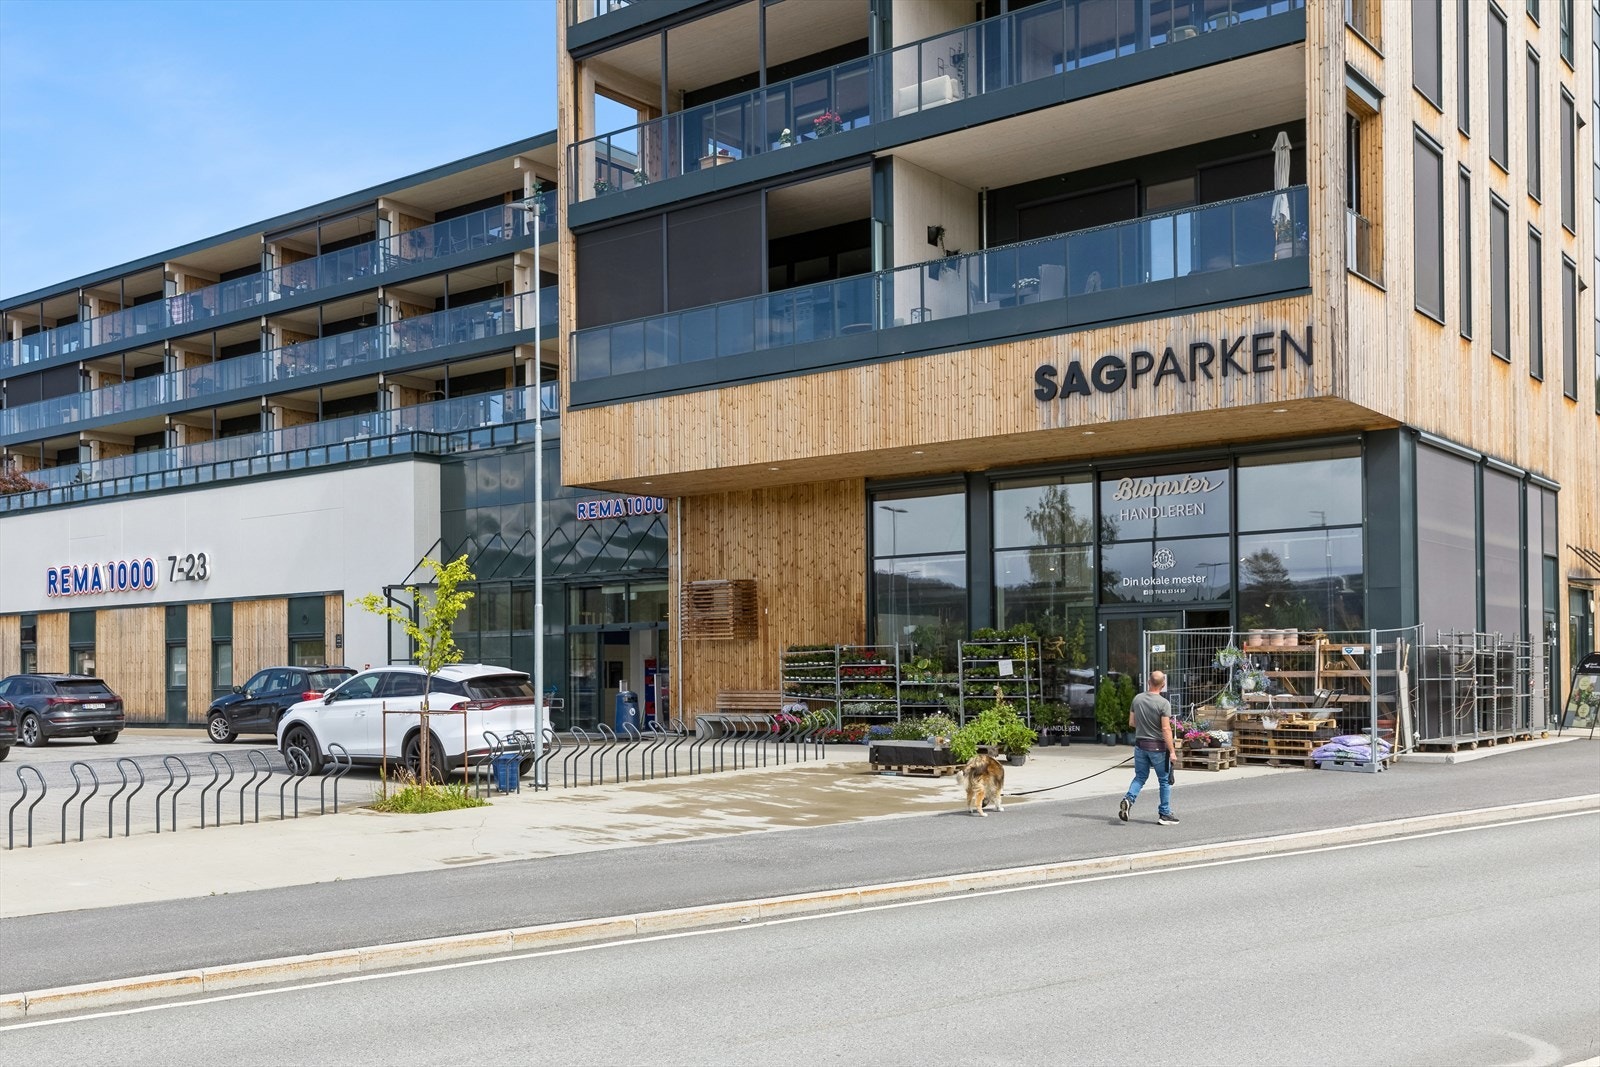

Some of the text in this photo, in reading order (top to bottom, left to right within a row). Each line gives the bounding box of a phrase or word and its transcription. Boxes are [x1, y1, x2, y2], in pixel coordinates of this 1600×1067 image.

[1034, 326, 1313, 401] SAGPARKEN
[1113, 474, 1224, 501] Blomster
[577, 496, 664, 519] REMA 1000
[1119, 502, 1206, 521] HANDLEREN
[47, 552, 207, 597] REMA 1000 7-23
[1122, 574, 1206, 586] Din lokale mester
